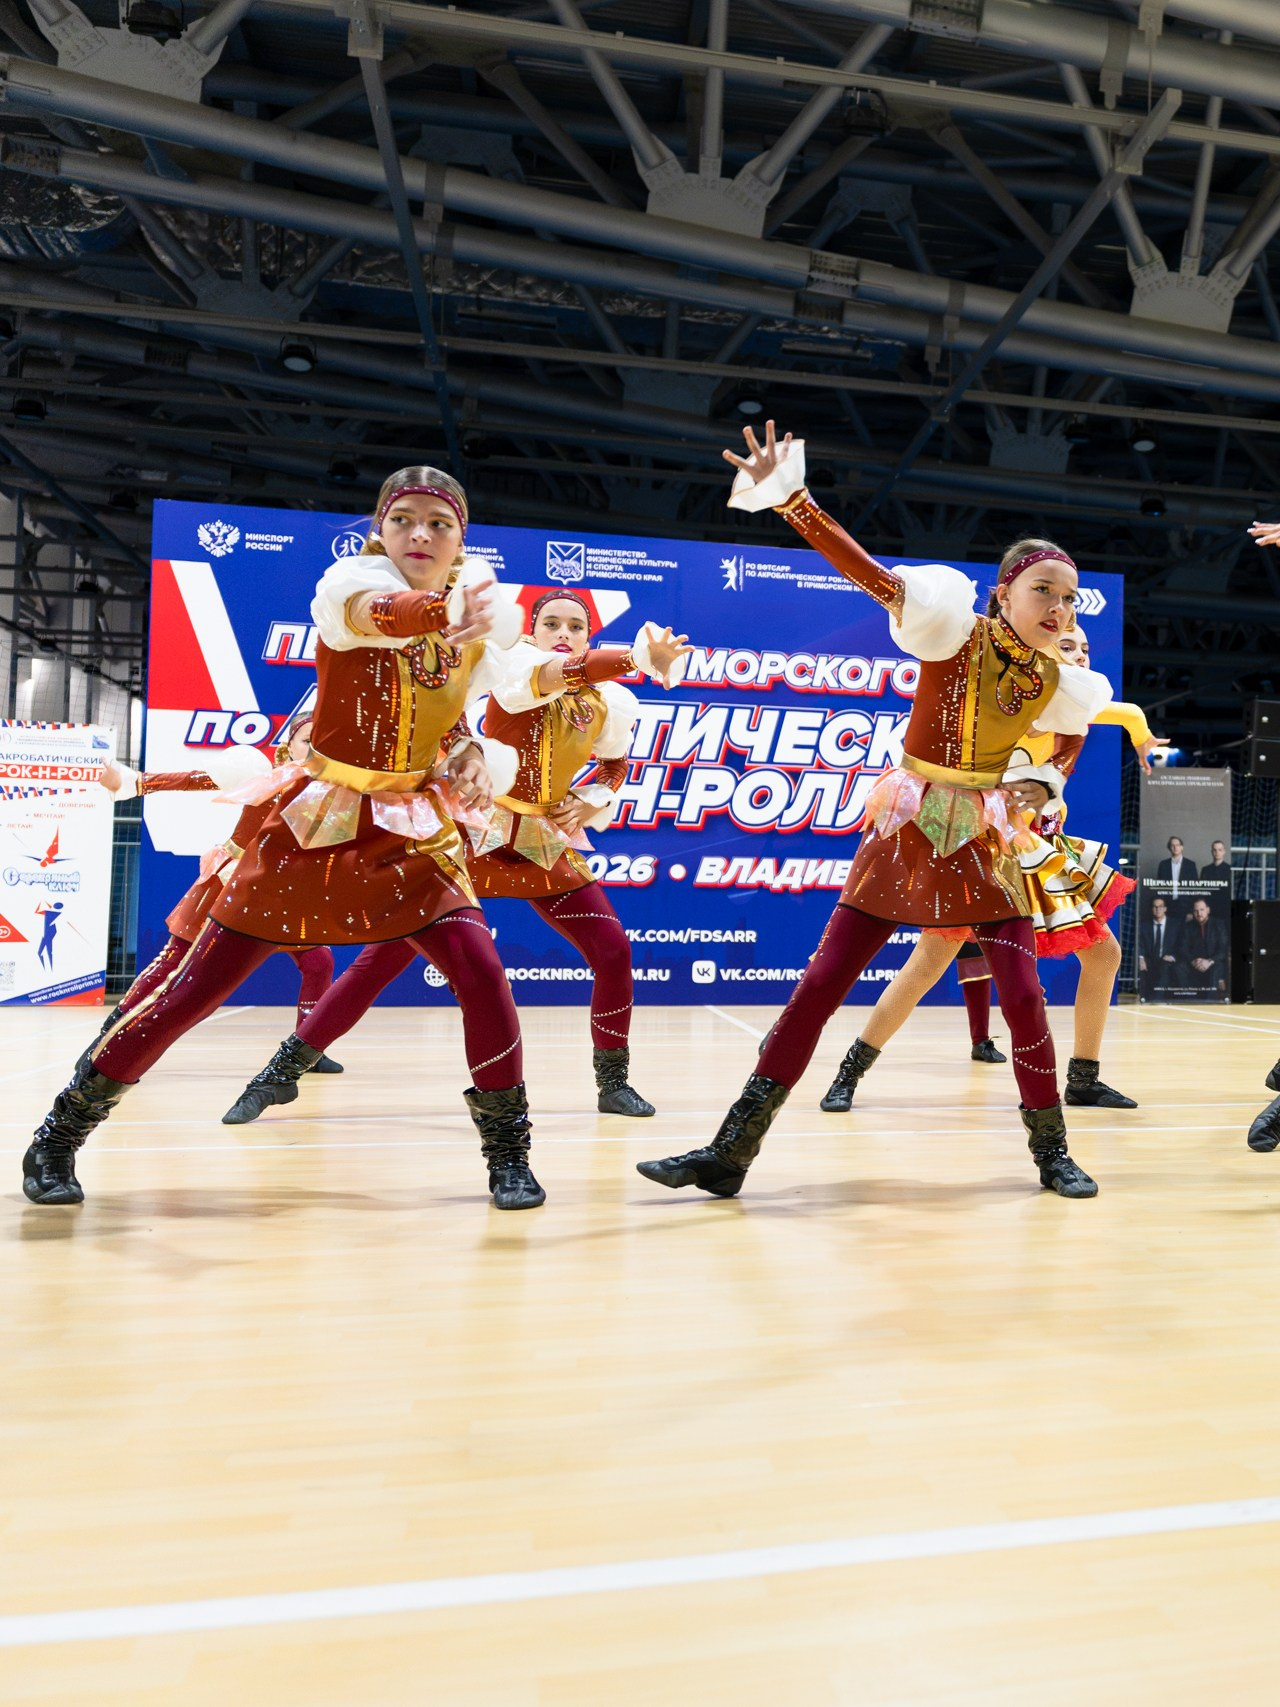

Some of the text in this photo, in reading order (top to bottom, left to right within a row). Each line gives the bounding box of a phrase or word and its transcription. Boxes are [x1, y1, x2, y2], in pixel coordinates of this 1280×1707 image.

[245, 532, 294, 543] МИНСПОРТ
[245, 543, 282, 551] РОССИИ
[586, 548, 647, 558] МИНИСТЕРСТВО
[586, 556, 678, 569] ФИЗИЧЕСКОЙ КУЛЬТУРЫ
[593, 563, 623, 572] СПОРТА
[586, 571, 641, 580] ПРИМОРСКОГО
[757, 571, 827, 582] АКРОБАТИЧЕСКОМУ
[804, 582, 852, 591] ПРИМОРСКОМ
[184, 708, 272, 746] ПО
[585, 853, 658, 884] 026
